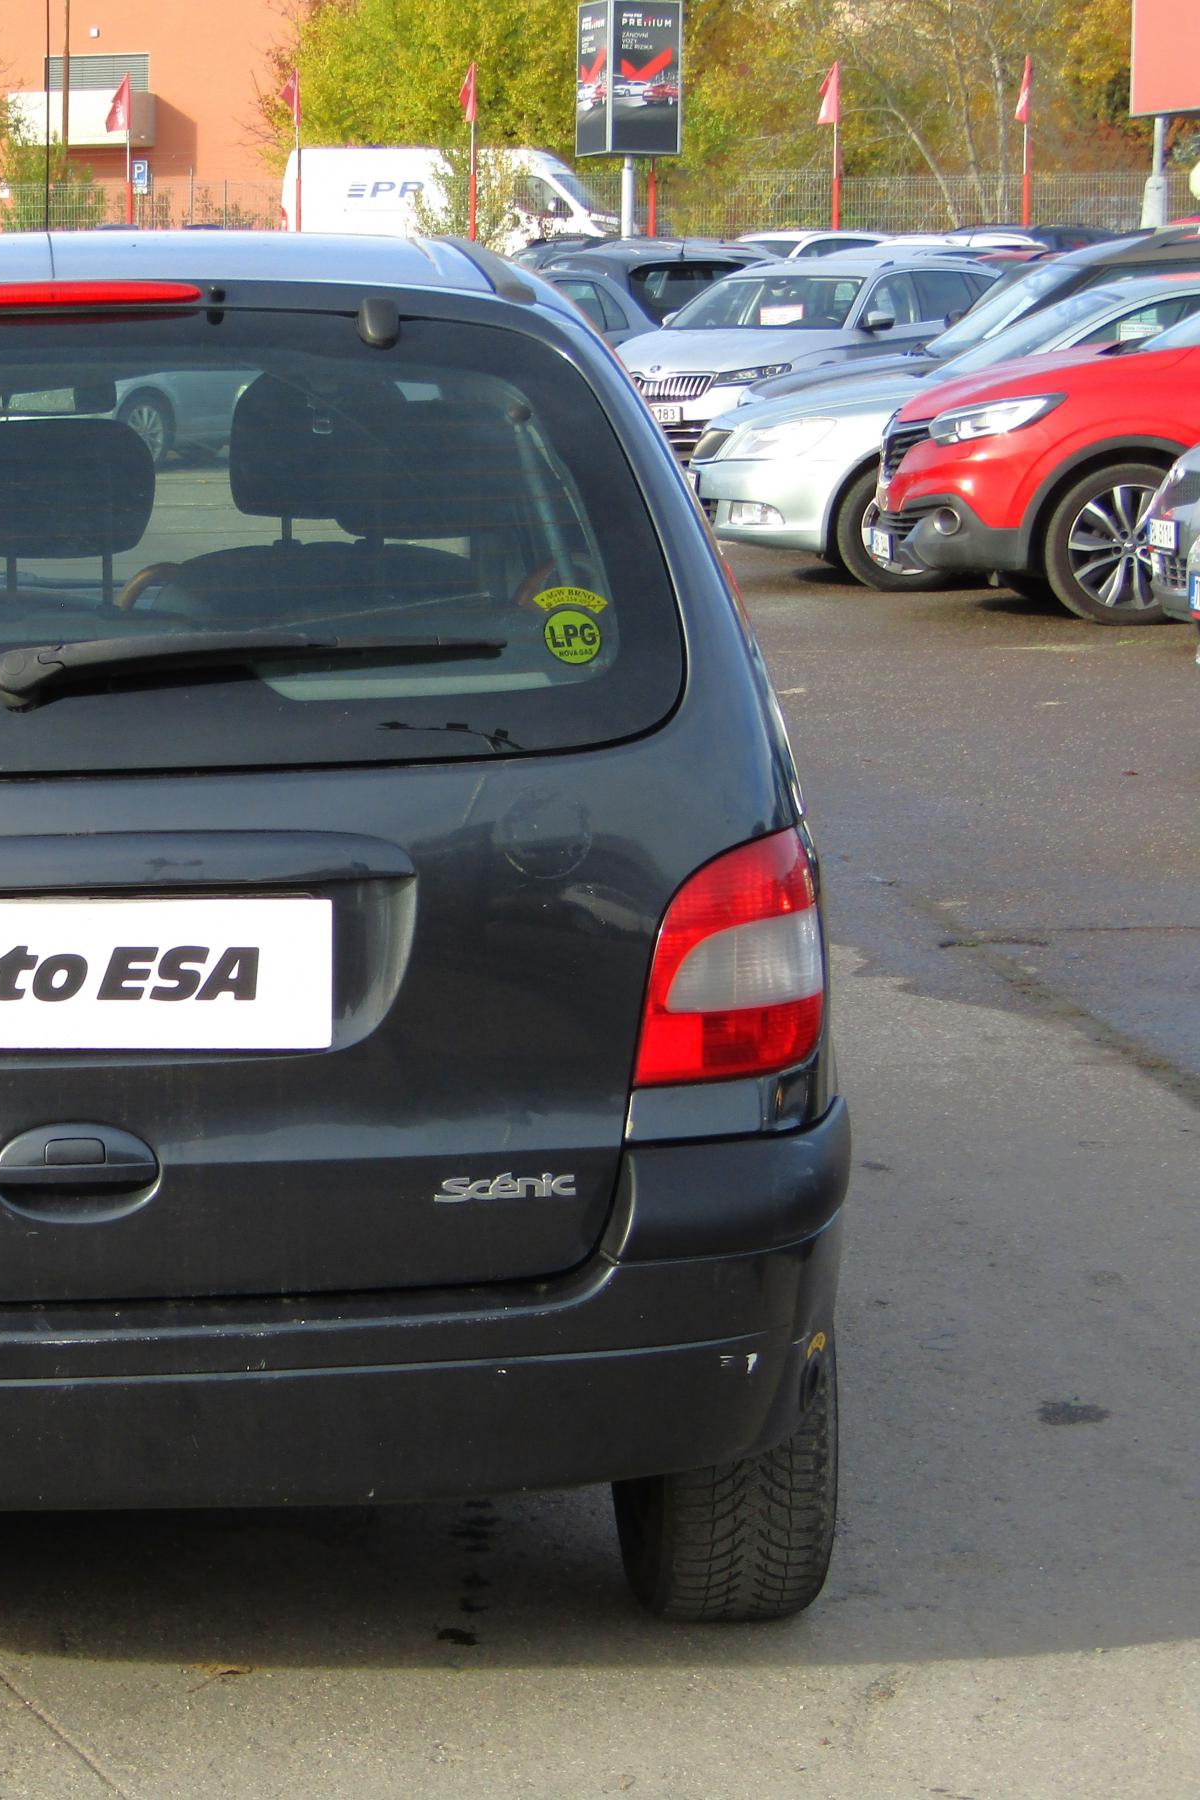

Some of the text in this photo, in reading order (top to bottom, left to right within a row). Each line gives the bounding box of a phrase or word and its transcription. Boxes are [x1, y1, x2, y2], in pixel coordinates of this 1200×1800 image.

[622, 17, 672, 28] PREMIUM
[652, 408, 675, 421] 183
[567, 588, 596, 601] BRNO
[548, 623, 597, 649] LPG
[96, 945, 260, 1001] ESA
[434, 1171, 576, 1203] Scénic
